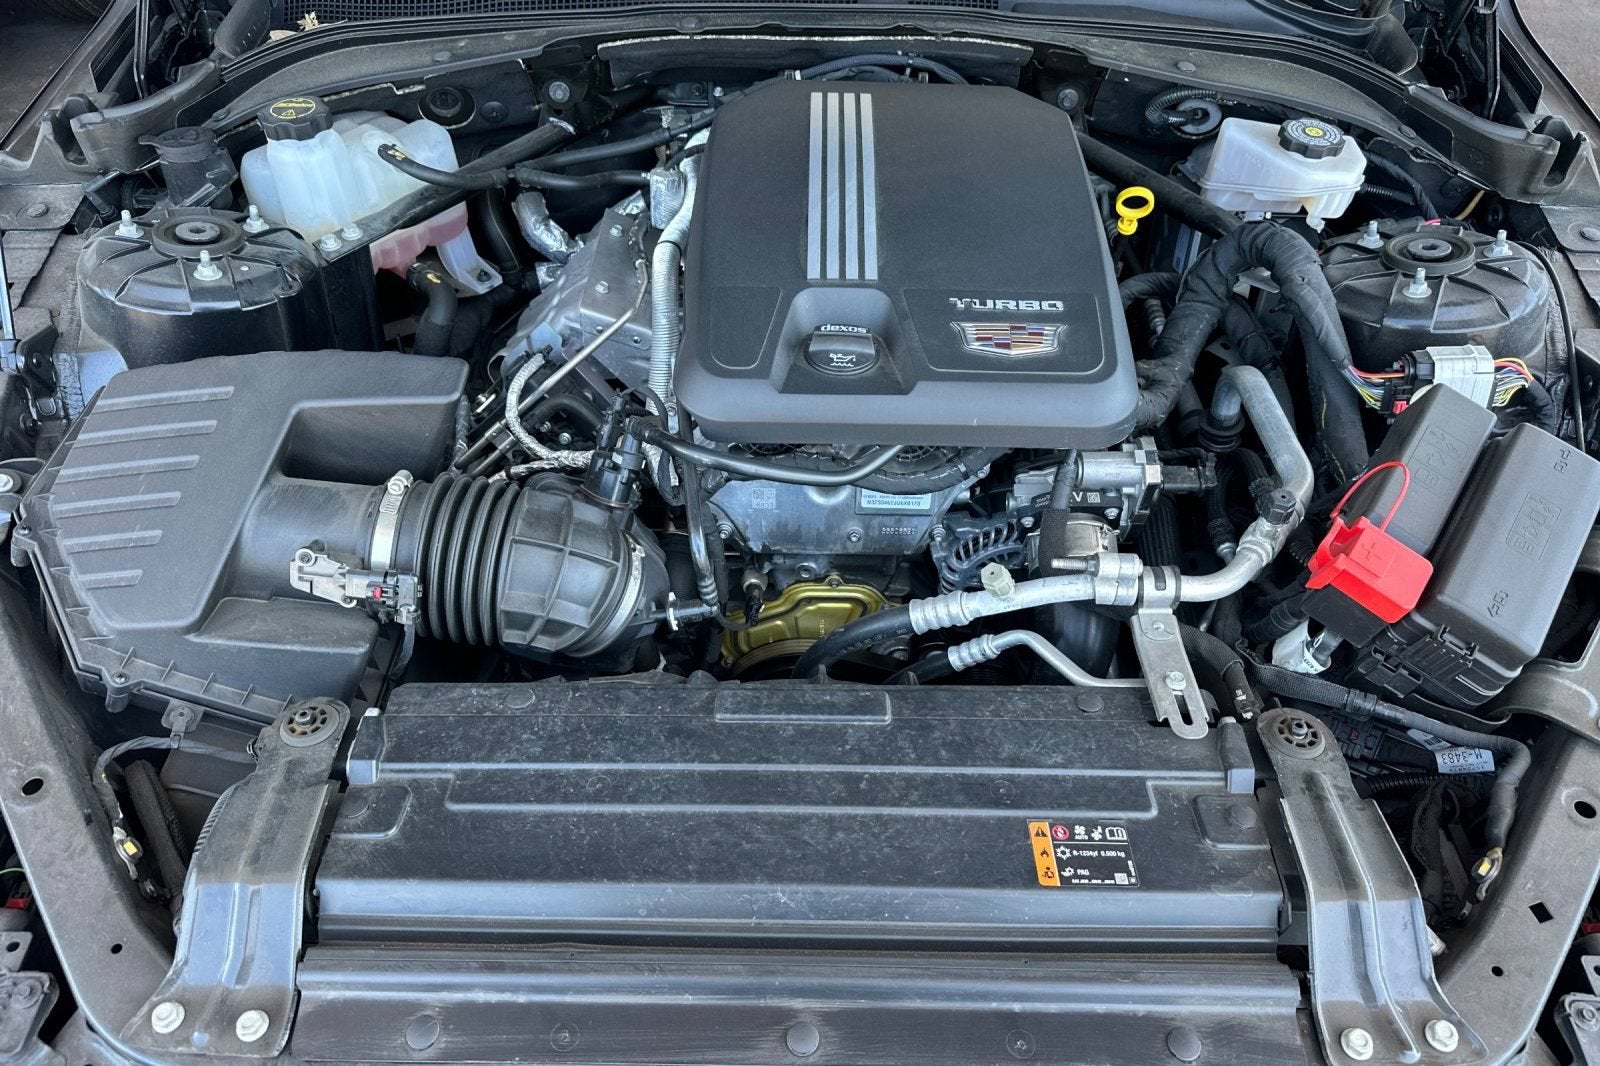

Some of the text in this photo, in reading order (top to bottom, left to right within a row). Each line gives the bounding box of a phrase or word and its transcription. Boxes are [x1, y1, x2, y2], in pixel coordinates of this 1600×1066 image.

[949, 297, 1064, 310] TURBO
[820, 324, 867, 334] dexos
[1441, 748, 1482, 764] M-3483
